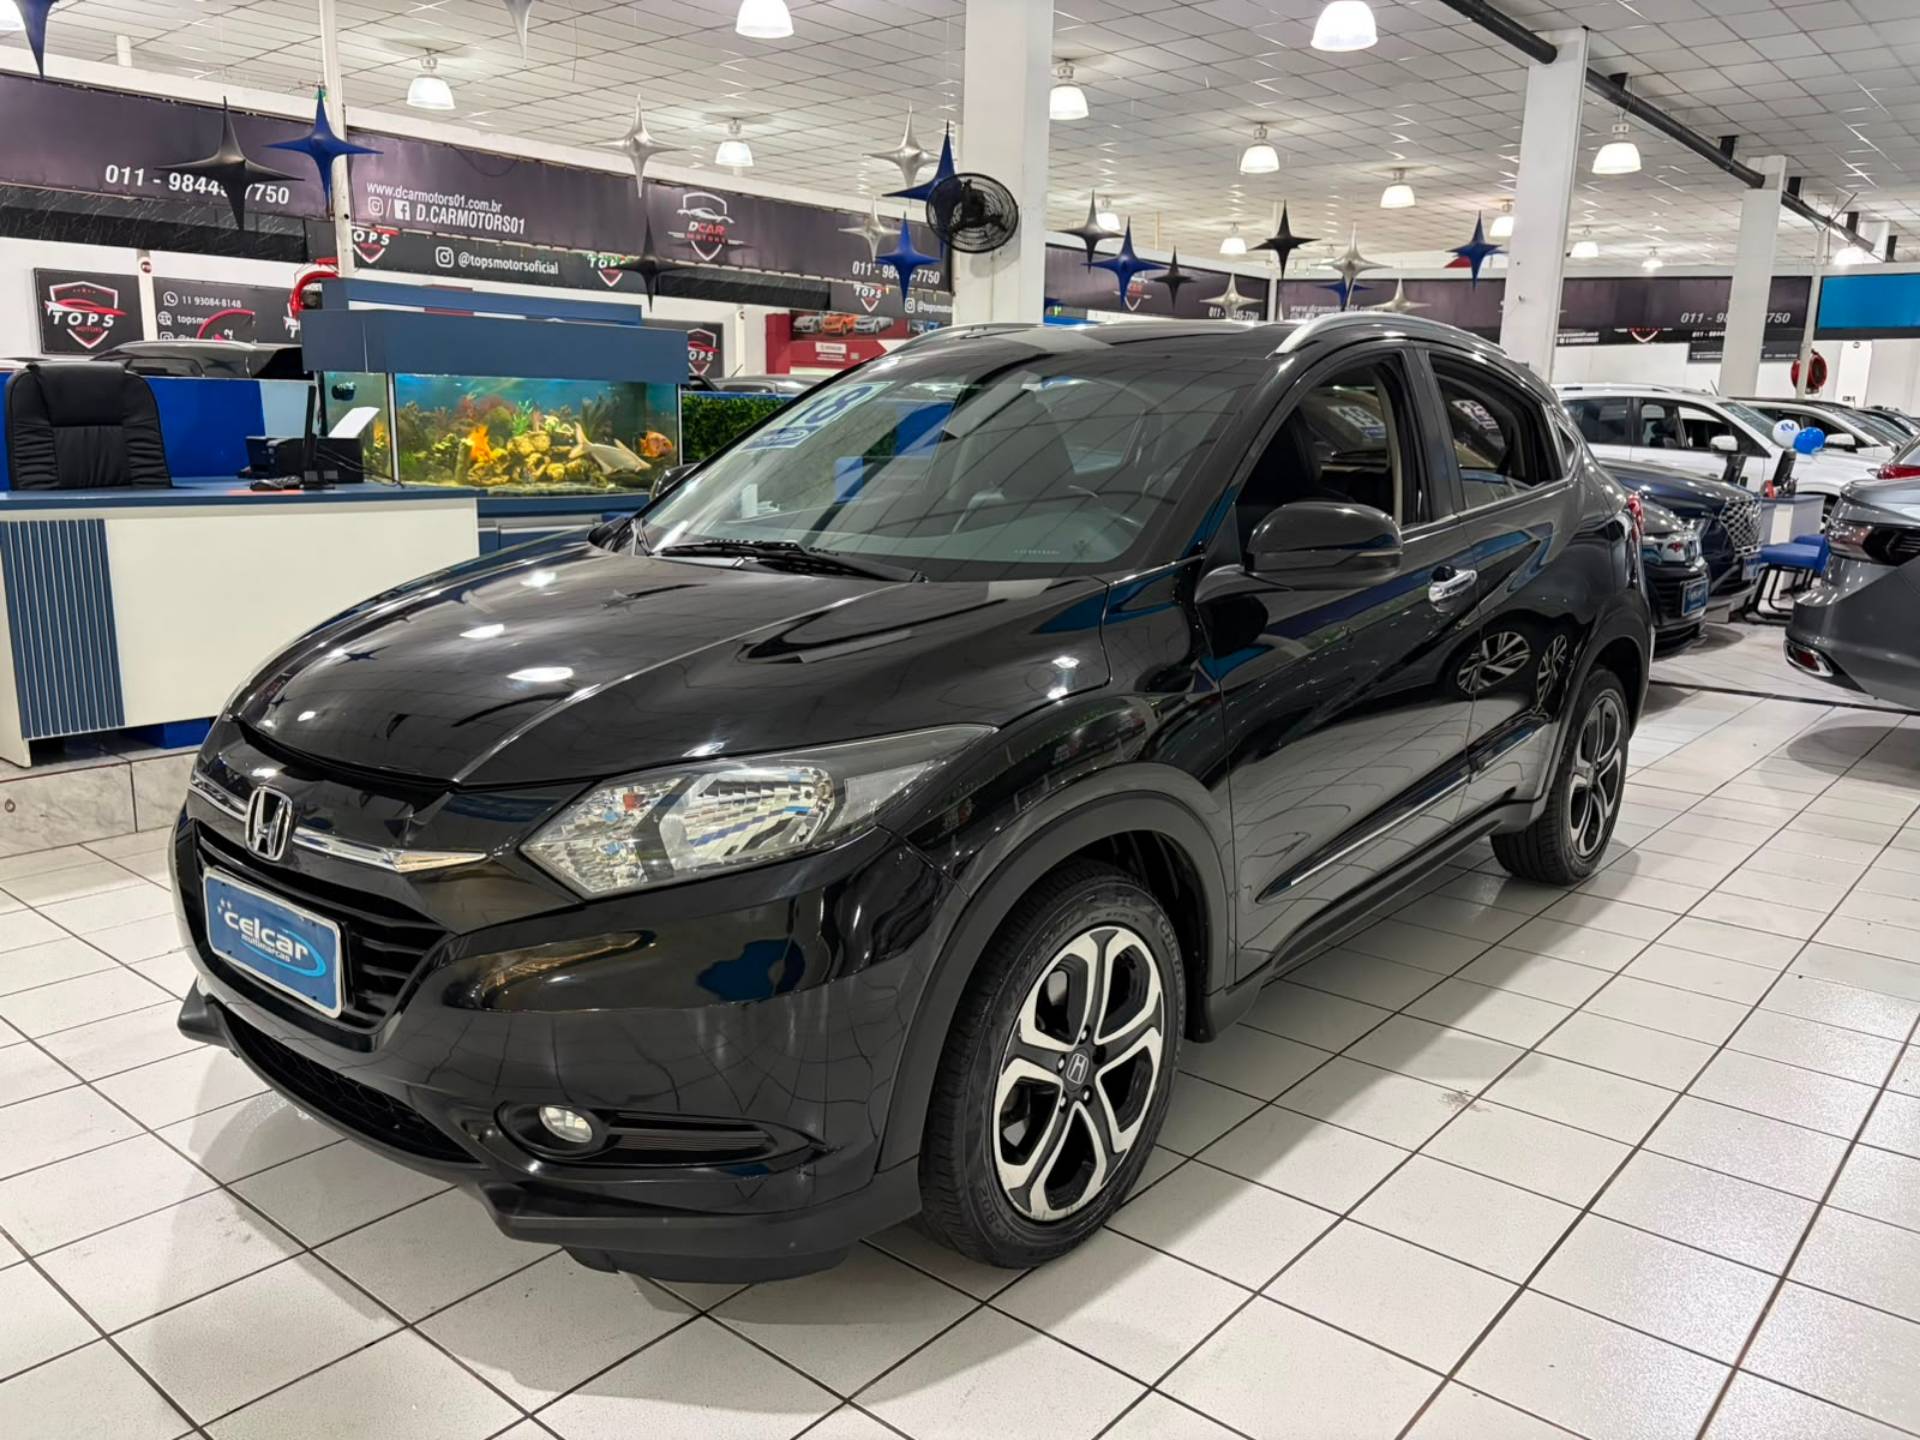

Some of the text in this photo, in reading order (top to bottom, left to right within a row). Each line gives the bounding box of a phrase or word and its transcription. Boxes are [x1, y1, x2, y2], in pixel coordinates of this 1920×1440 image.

[105, 164, 145, 187] 011
[366, 182, 503, 213] www.dcarmotors01.com.br
[415, 203, 526, 235] D.CARMOTORS01
[688, 220, 726, 236] DCAR
[353, 230, 391, 246] OPS
[458, 251, 559, 275] @topsmotorsoficial
[852, 261, 872, 276] 011
[854, 286, 882, 299] TOPS
[52, 311, 115, 328] TOPS
[1680, 312, 1705, 324] 011
[688, 351, 714, 362] OPS
[223, 912, 309, 961] celcar
